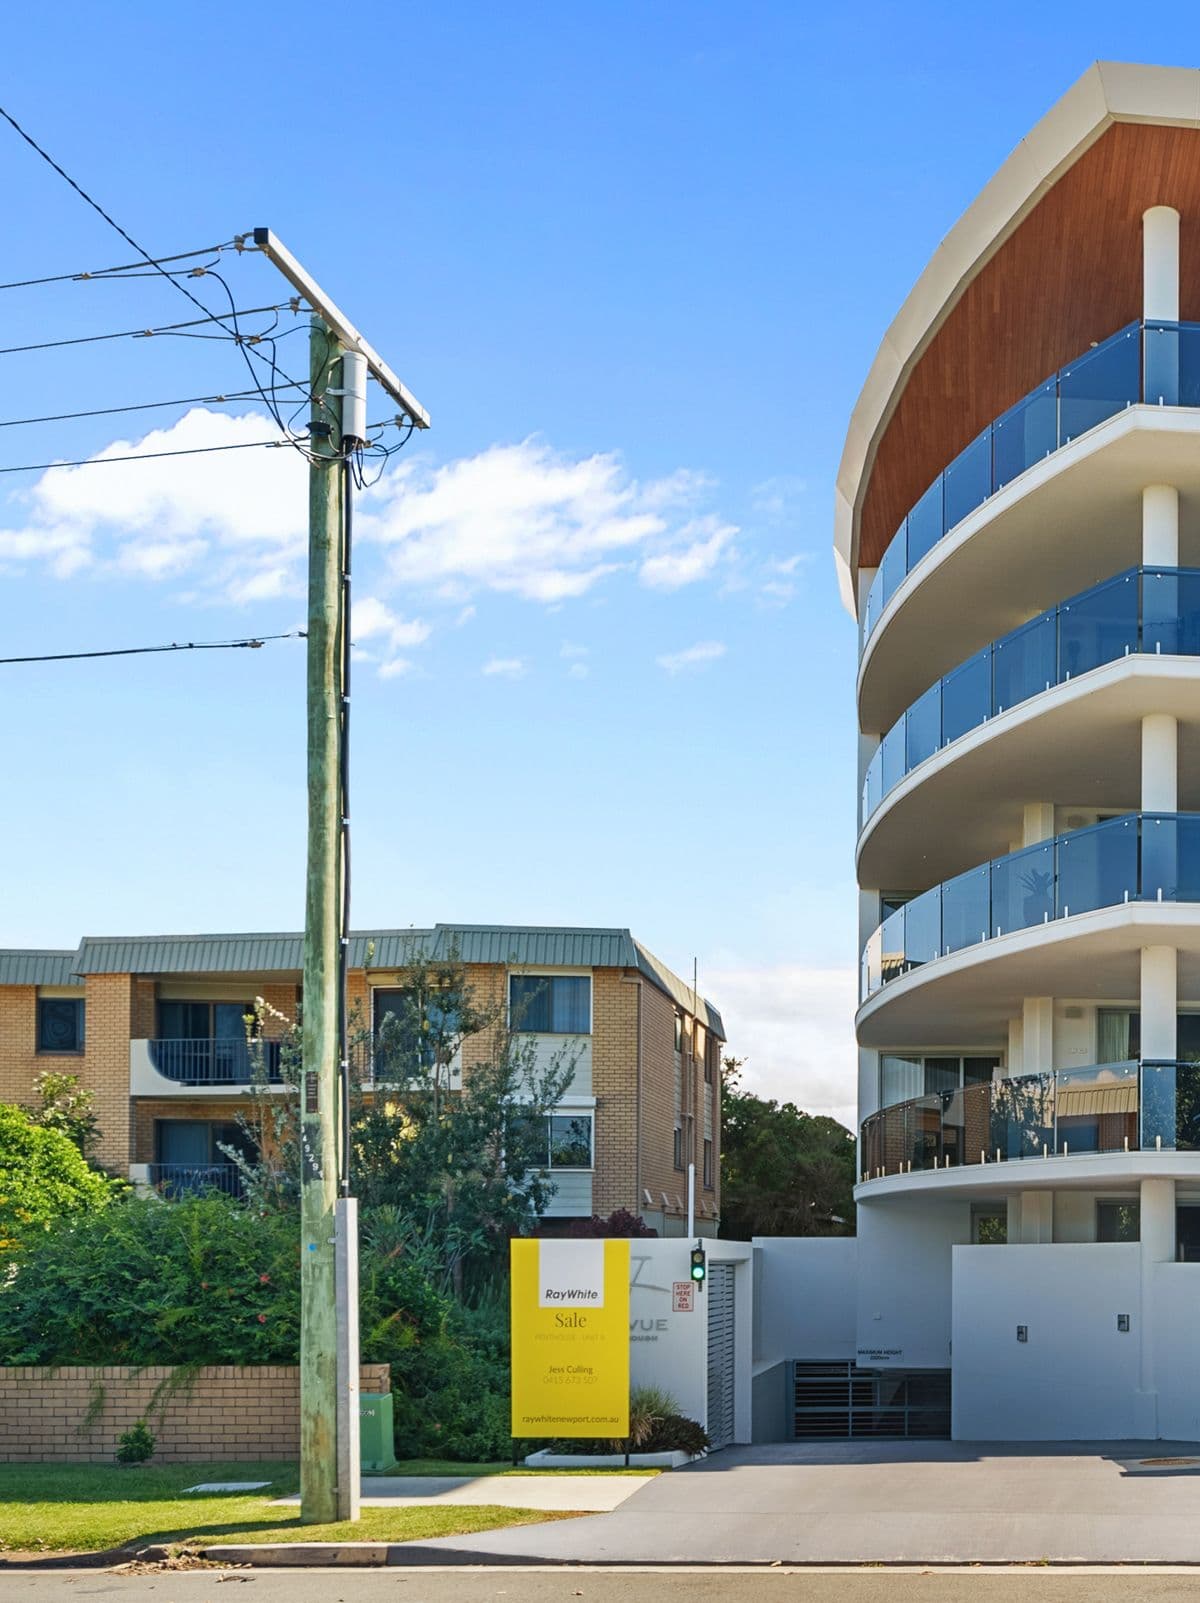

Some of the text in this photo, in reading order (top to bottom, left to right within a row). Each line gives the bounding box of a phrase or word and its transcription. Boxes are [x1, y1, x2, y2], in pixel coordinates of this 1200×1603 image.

[545, 1289, 599, 1301] RayWhite
[554, 1312, 588, 1328] Sale
[549, 1365, 594, 1375] Jess Culling
[522, 1414, 619, 1424] raywhitenewport.com.au
